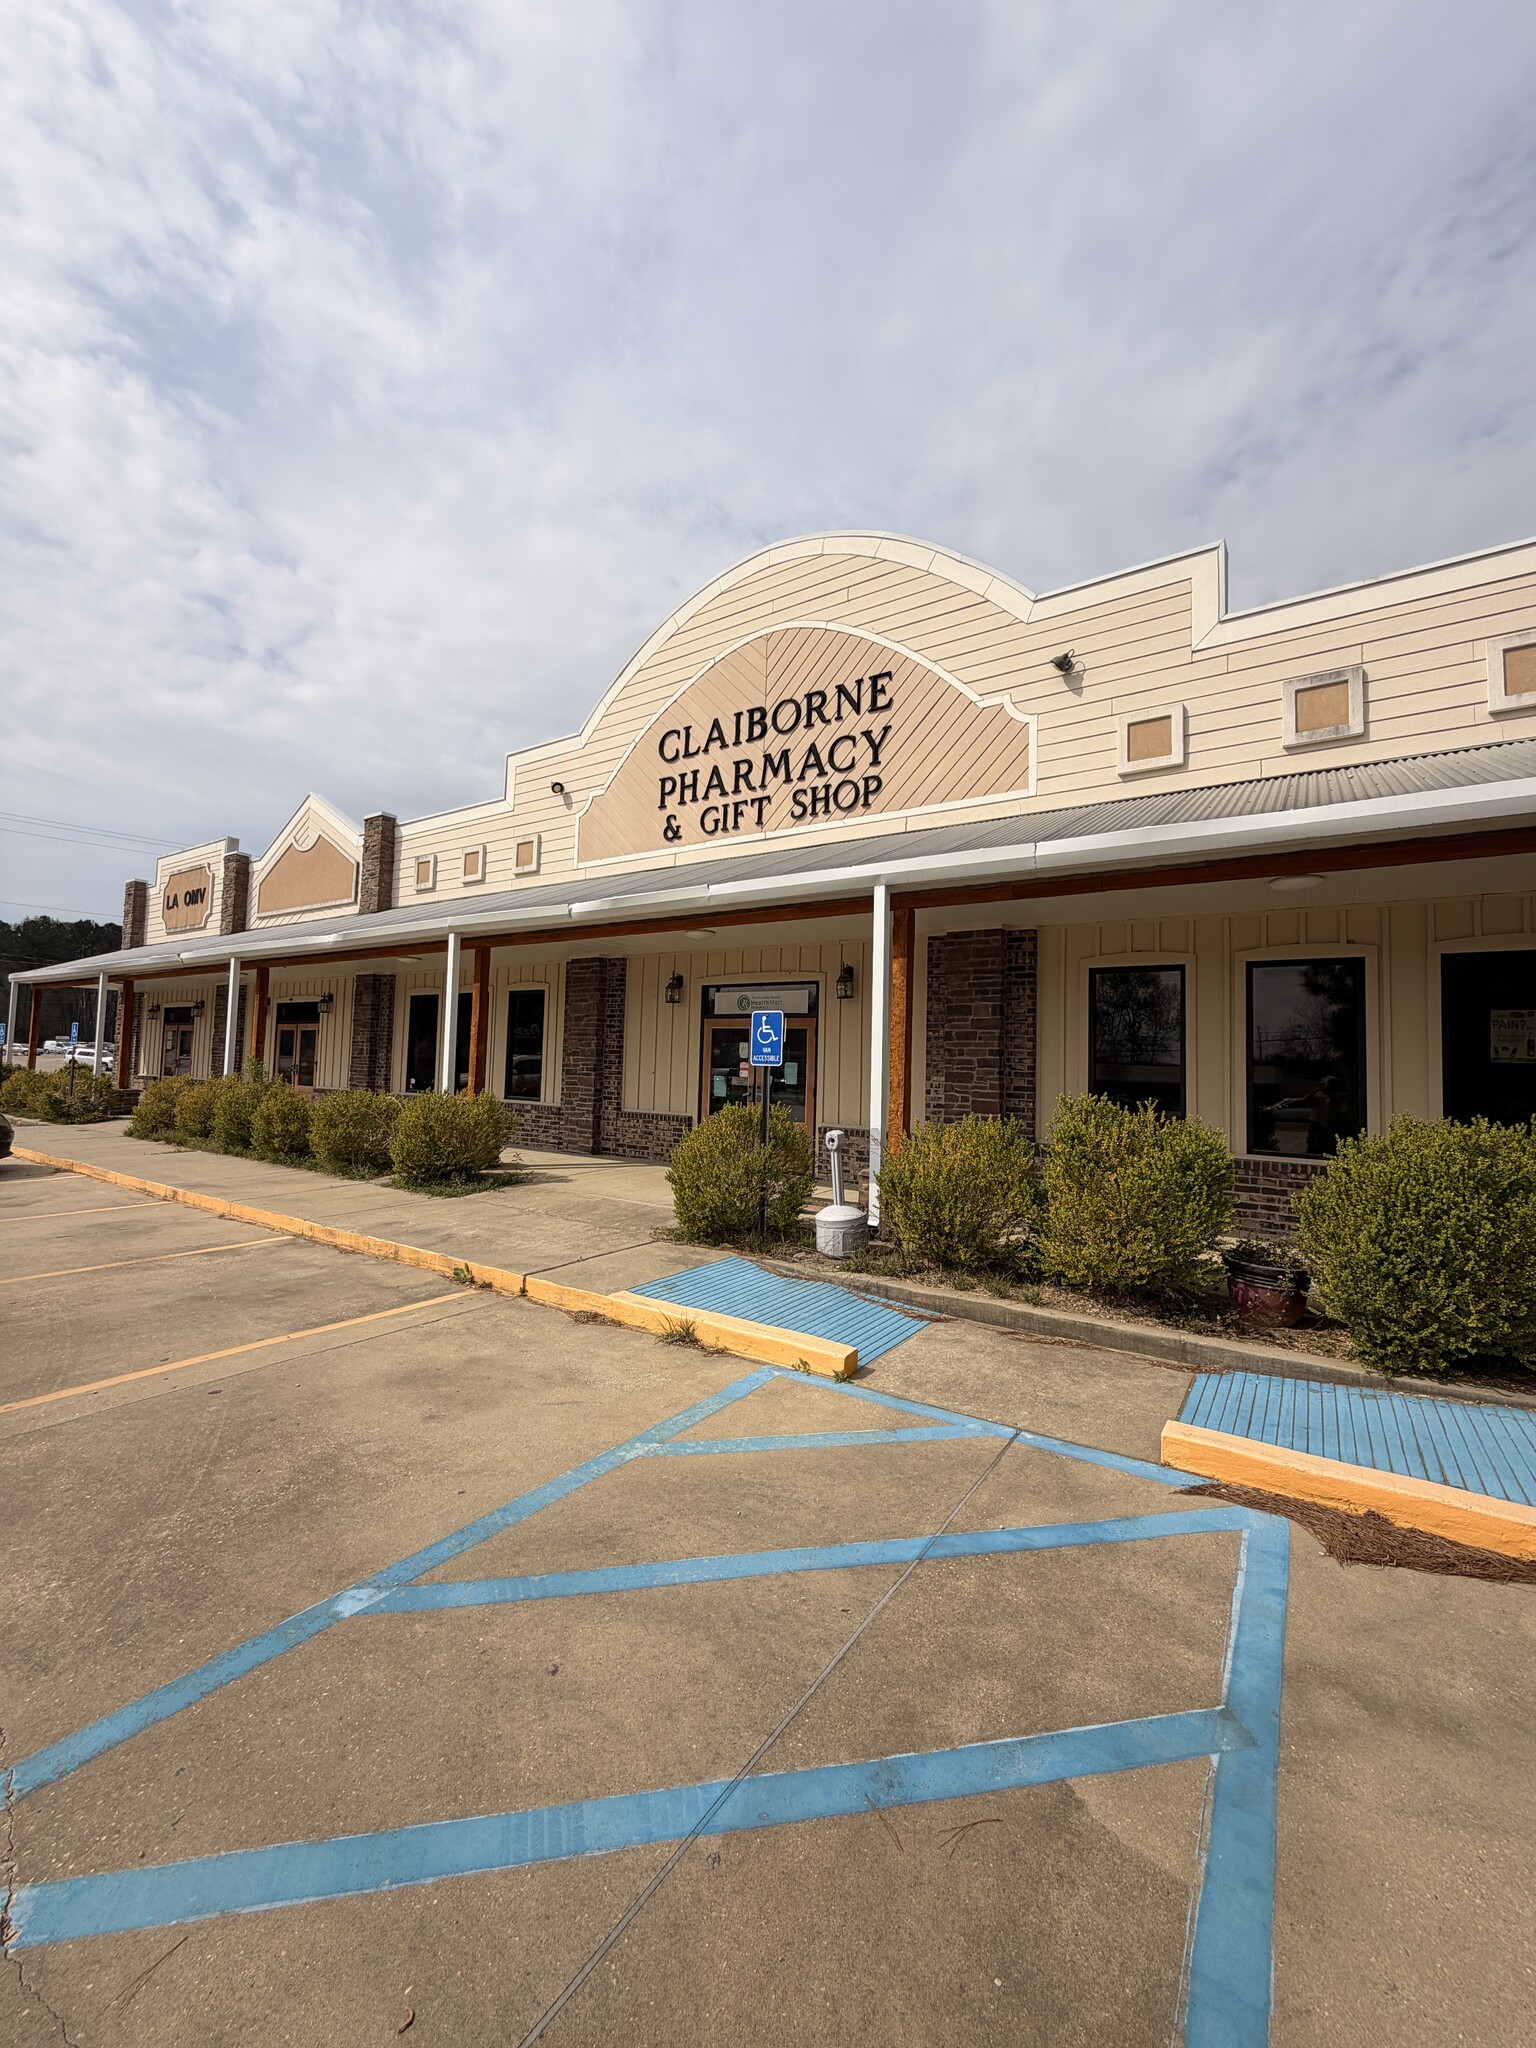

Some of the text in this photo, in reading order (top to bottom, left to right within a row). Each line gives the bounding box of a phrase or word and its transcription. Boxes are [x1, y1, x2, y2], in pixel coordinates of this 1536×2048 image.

[658, 670, 894, 763] CLAIBORNE
[658, 725, 893, 810] PHARMACY
[662, 775, 883, 842] & GIFT SHOP
[166, 887, 206, 910] LA OMV
[1493, 1019, 1526, 1030] PAIN?
[753, 1054, 780, 1062] ACCESSIBLE
